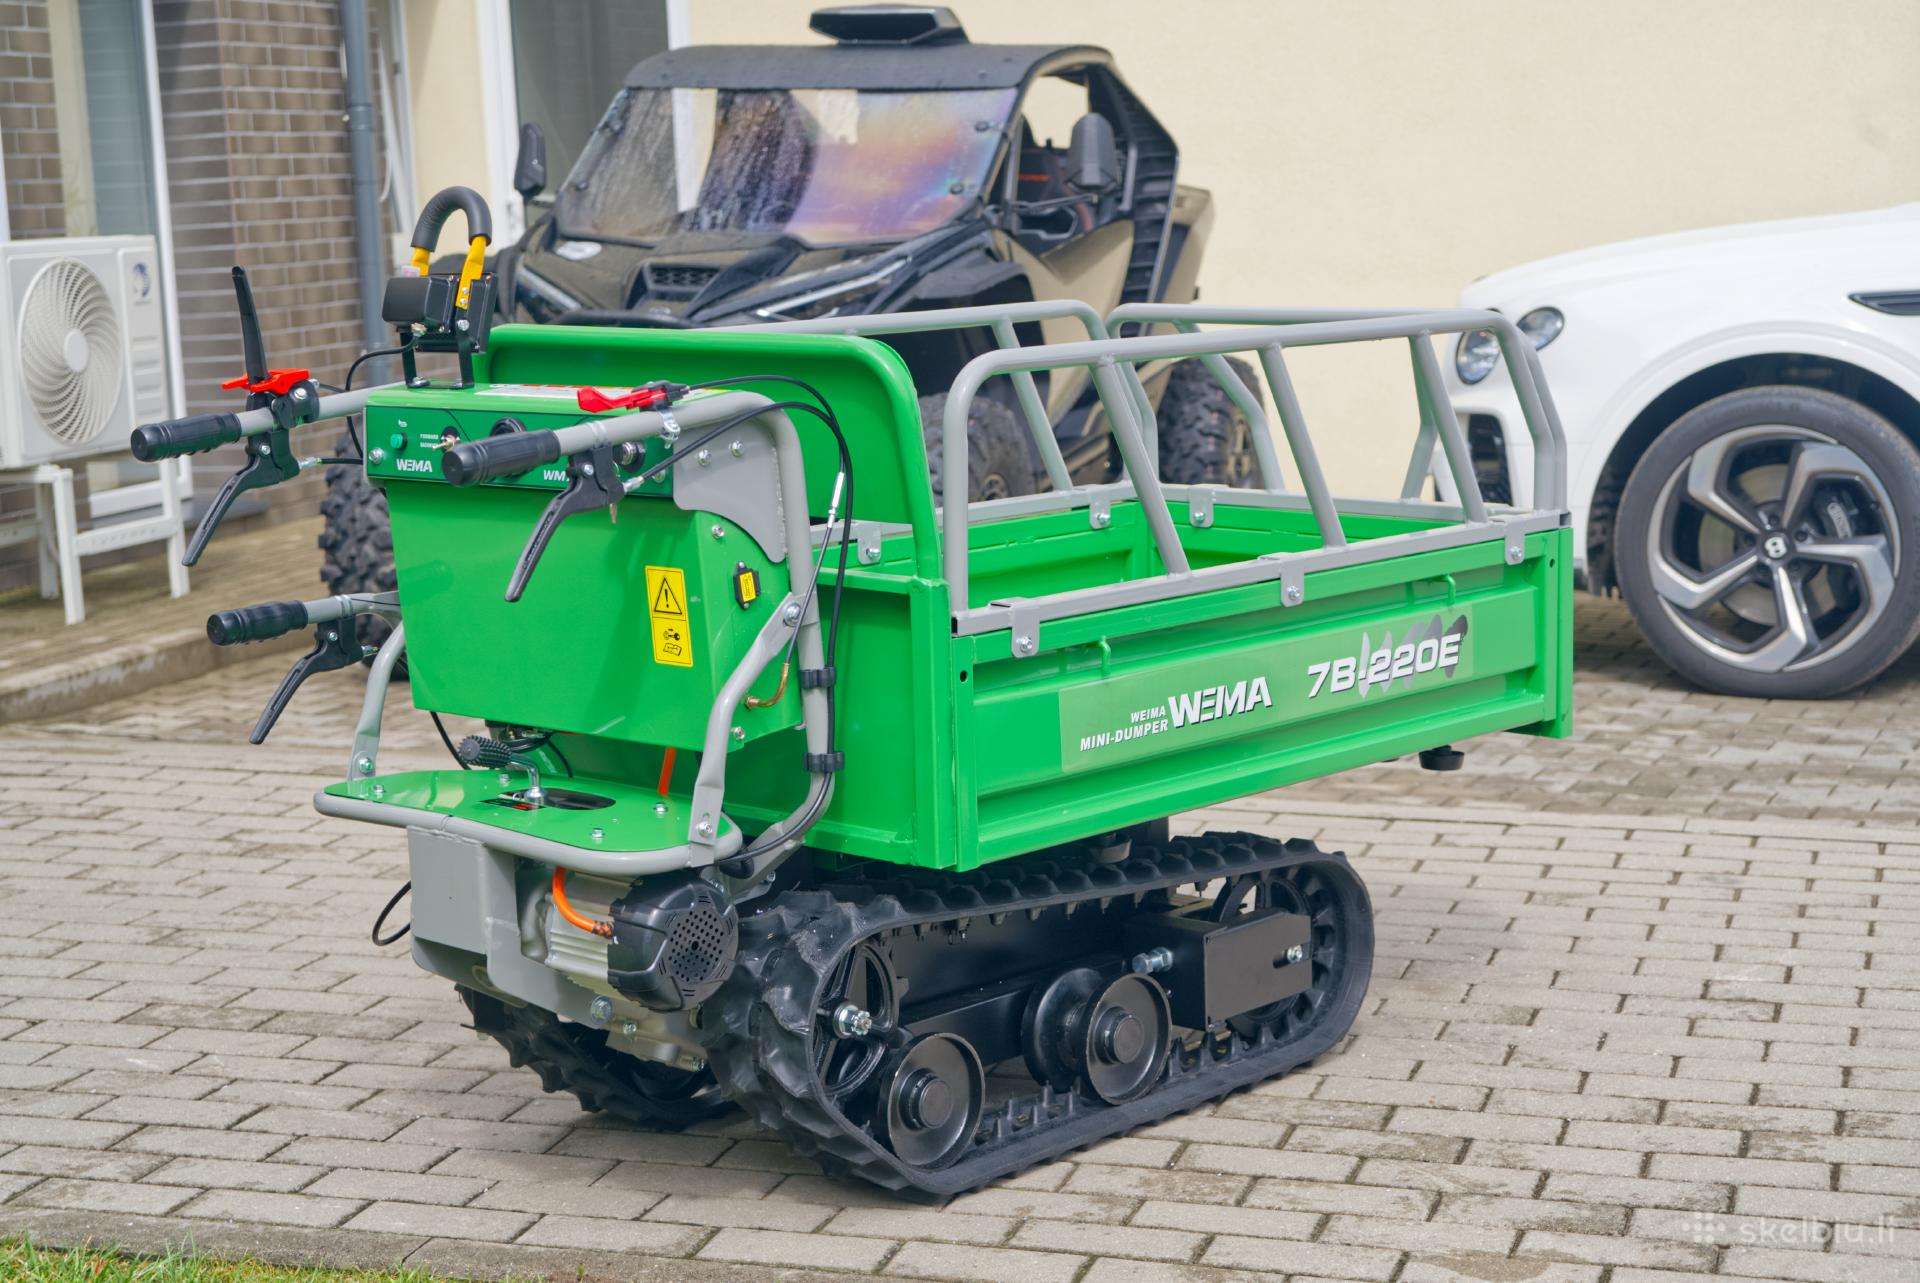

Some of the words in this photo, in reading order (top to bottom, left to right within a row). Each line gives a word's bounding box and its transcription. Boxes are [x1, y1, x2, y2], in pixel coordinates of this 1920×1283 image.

[544, 469, 569, 481] WM
[1131, 706, 1166, 723] WEIMA
[1080, 719, 1168, 751] MINI-DUMPER
